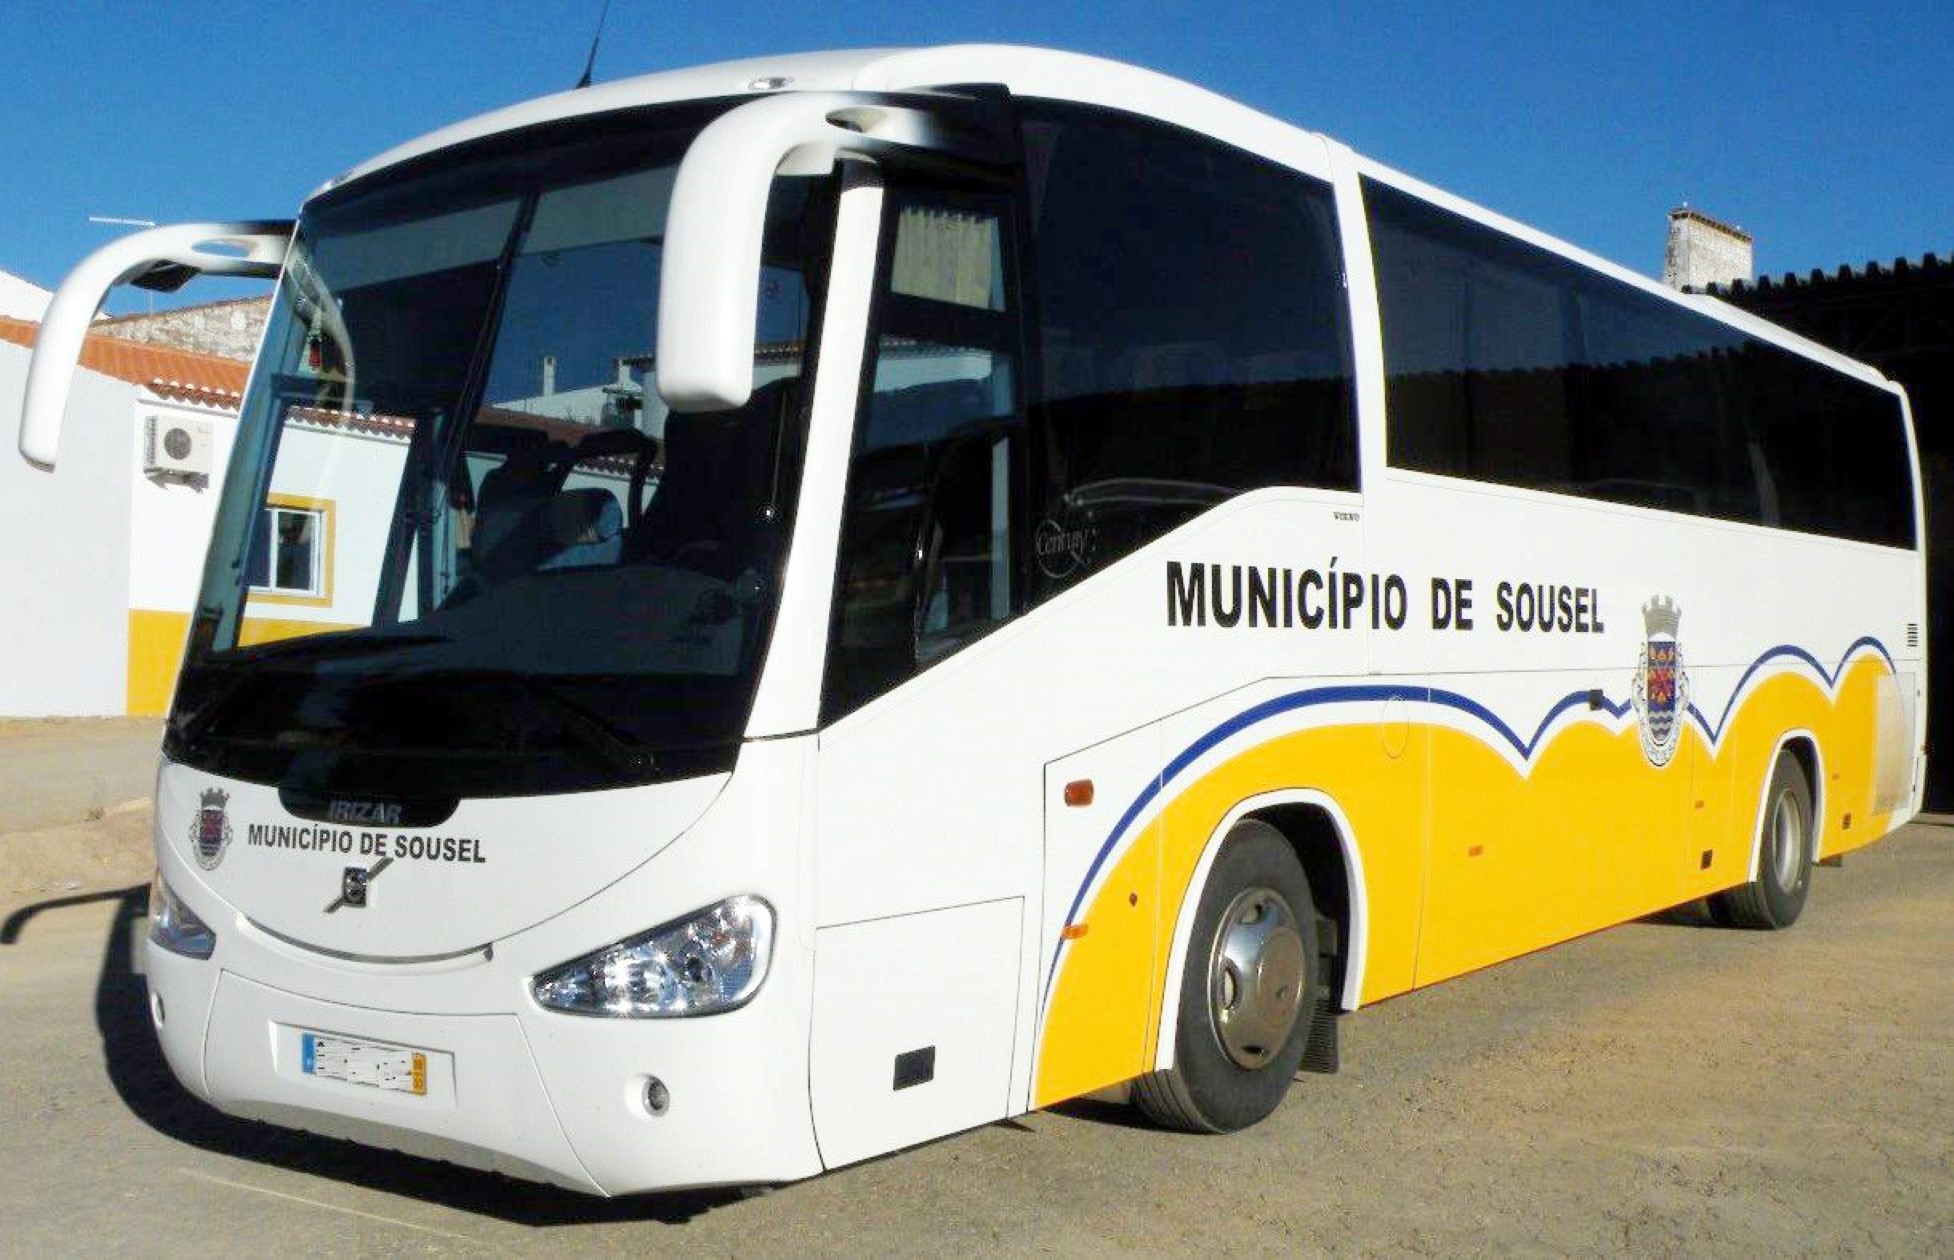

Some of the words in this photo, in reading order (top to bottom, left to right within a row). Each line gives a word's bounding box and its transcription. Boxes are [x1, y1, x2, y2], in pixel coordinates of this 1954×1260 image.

[1166, 556, 1408, 630] MUNICÍPIO
[1431, 577, 1474, 631] DE
[1496, 581, 1604, 634] SOUSEL
[331, 800, 402, 824] IRIZAR
[248, 823, 353, 854] MUNICÍPIO
[359, 832, 388, 857] DE
[395, 835, 486, 864] SOUSEL
